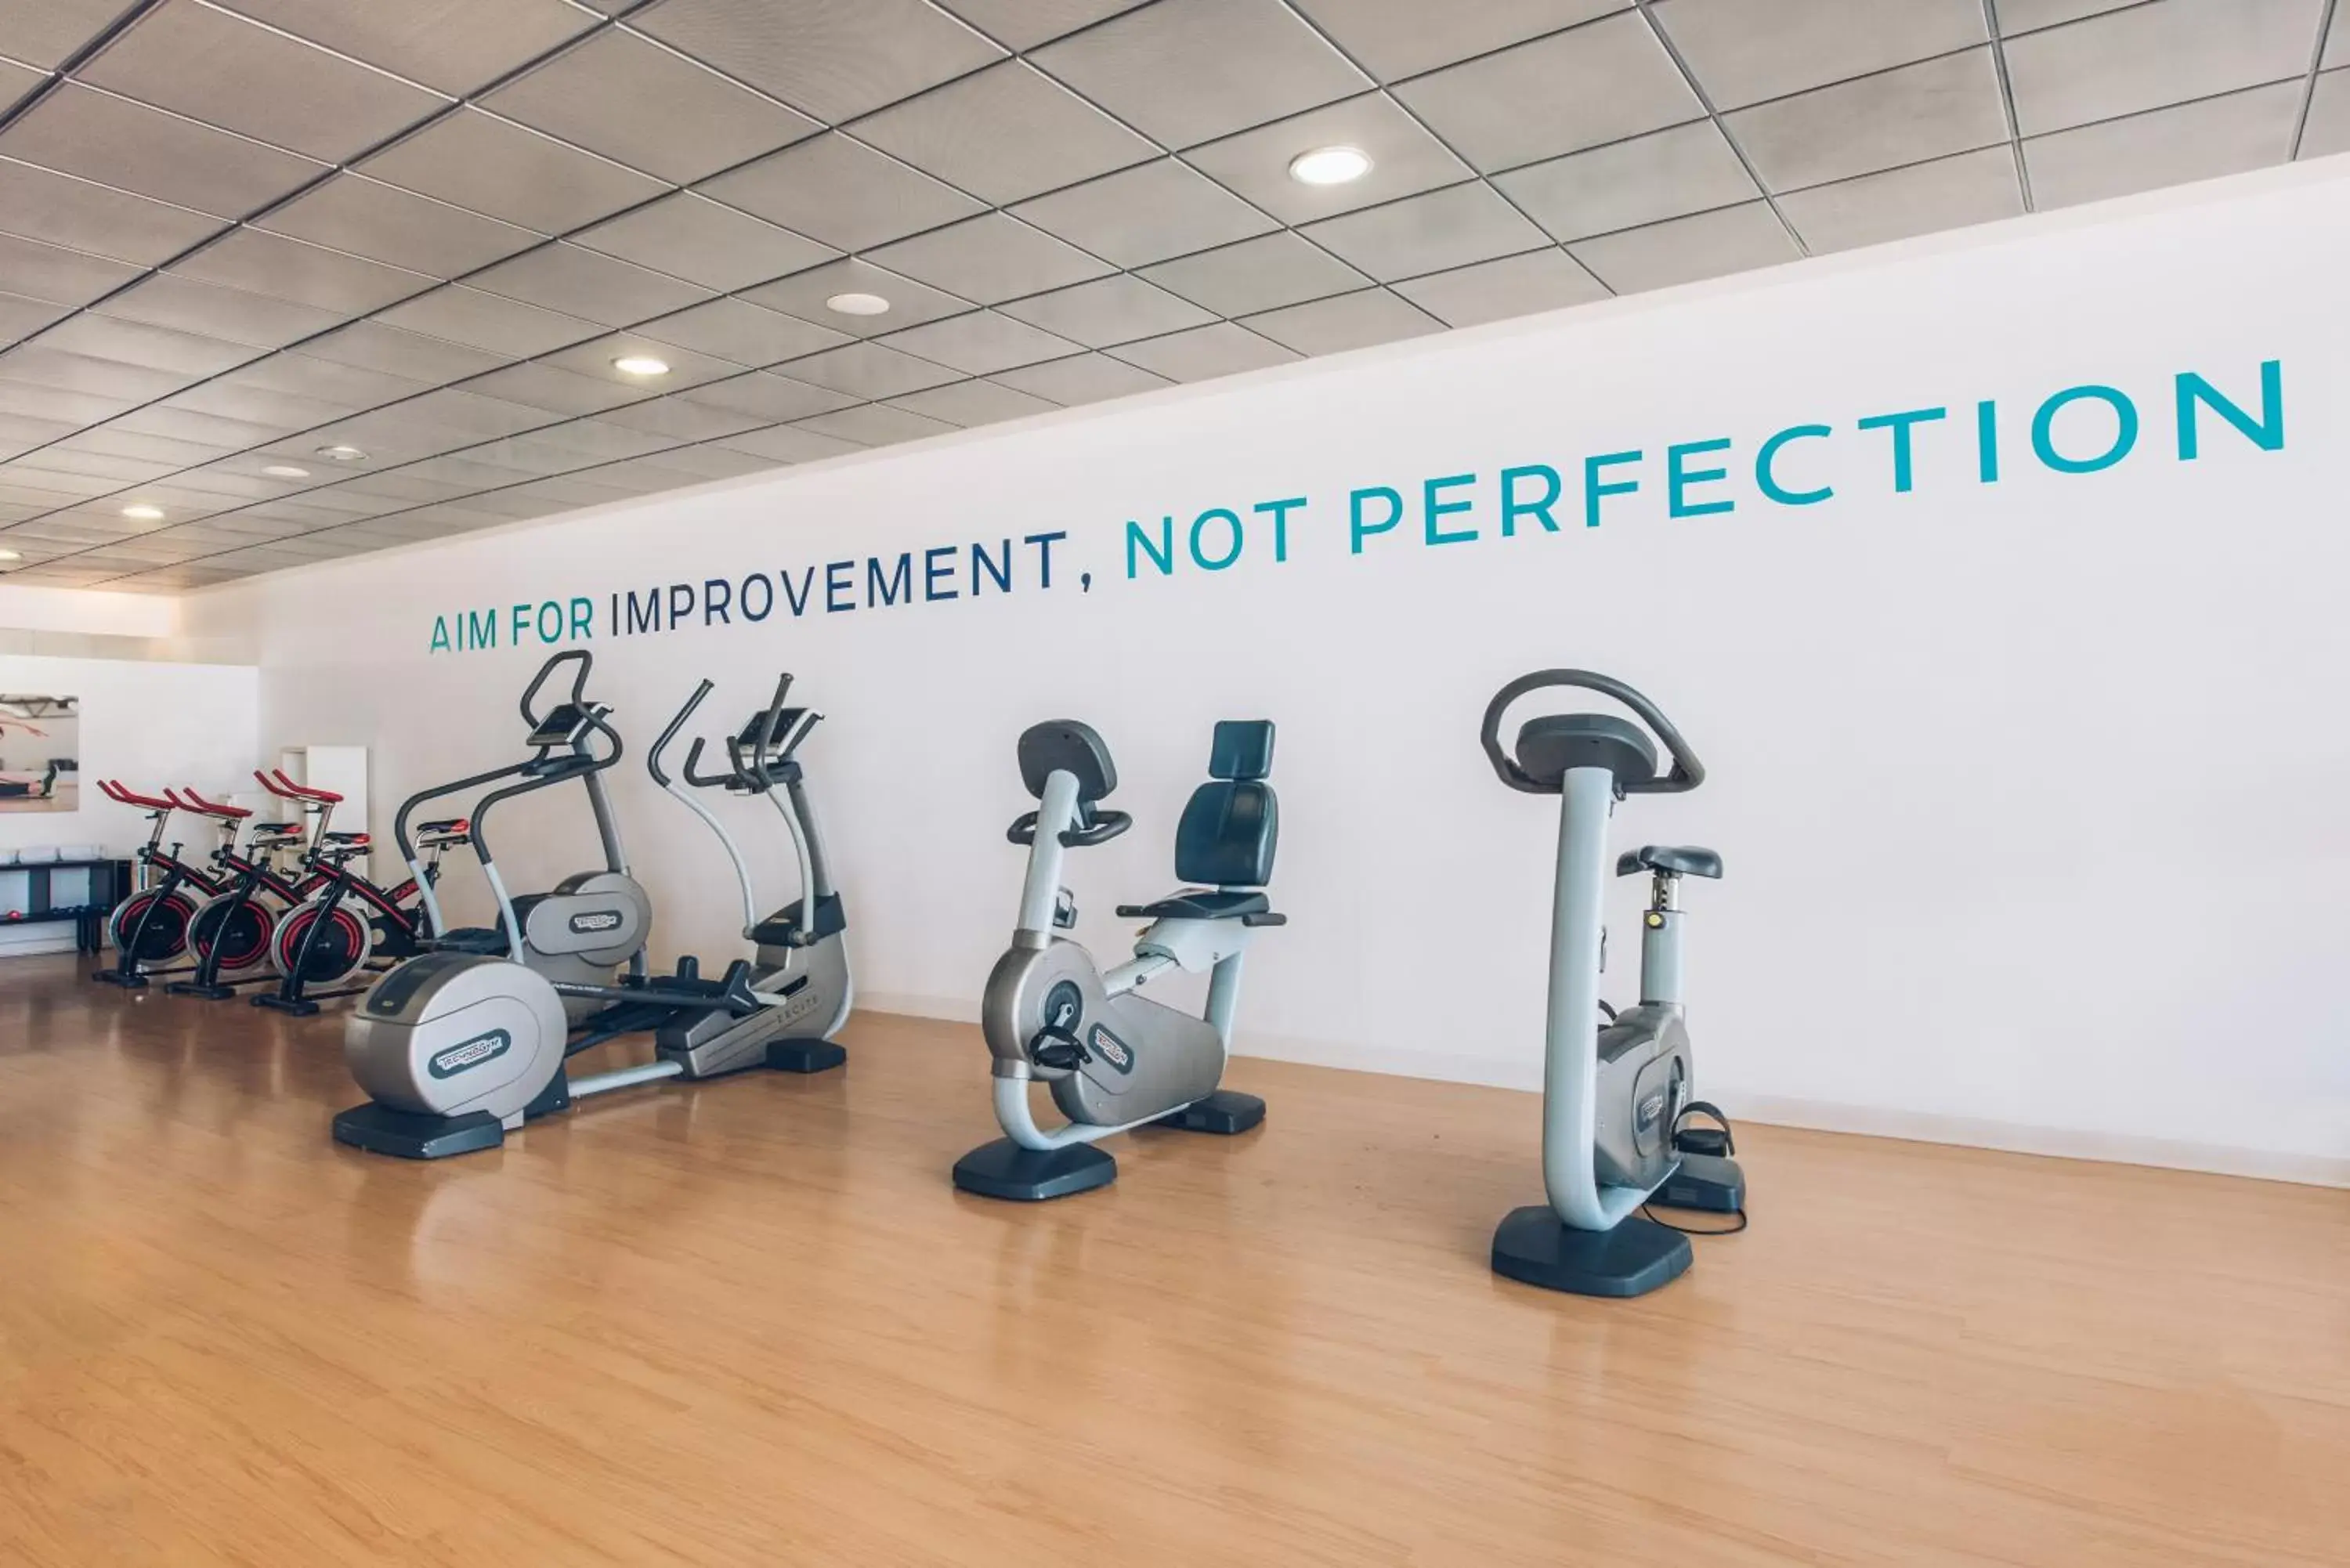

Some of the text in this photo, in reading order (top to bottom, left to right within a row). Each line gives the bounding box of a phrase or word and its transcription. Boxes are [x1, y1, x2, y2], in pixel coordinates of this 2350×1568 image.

[431, 358, 2287, 652] AIM FOR IMPROVEMENT, NOT PERFECTION
